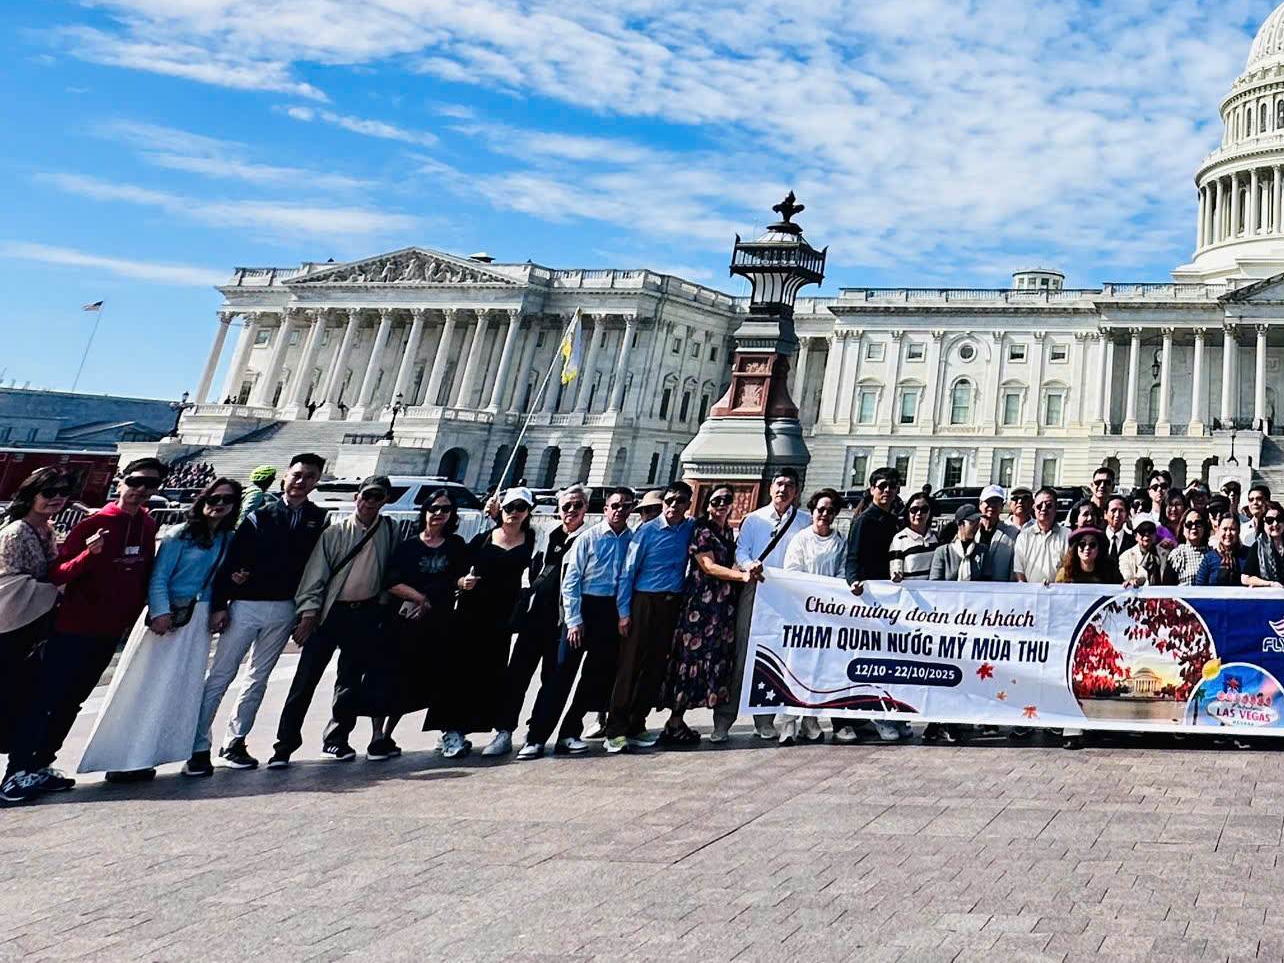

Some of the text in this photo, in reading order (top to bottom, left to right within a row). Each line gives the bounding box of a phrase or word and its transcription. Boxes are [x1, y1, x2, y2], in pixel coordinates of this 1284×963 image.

[805, 595, 847, 616] Chào
[905, 606, 950, 625] đoàn
[954, 608, 978, 626] du
[980, 608, 1035, 628] khách
[782, 624, 1050, 664] THAM QUAN NƯỚC MỸ MÙA THU
[854, 664, 886, 677] 12/10
[894, 666, 955, 680] 22/10/2025
[1216, 707, 1236, 718] LAS
[1239, 709, 1271, 723] VEGAS
